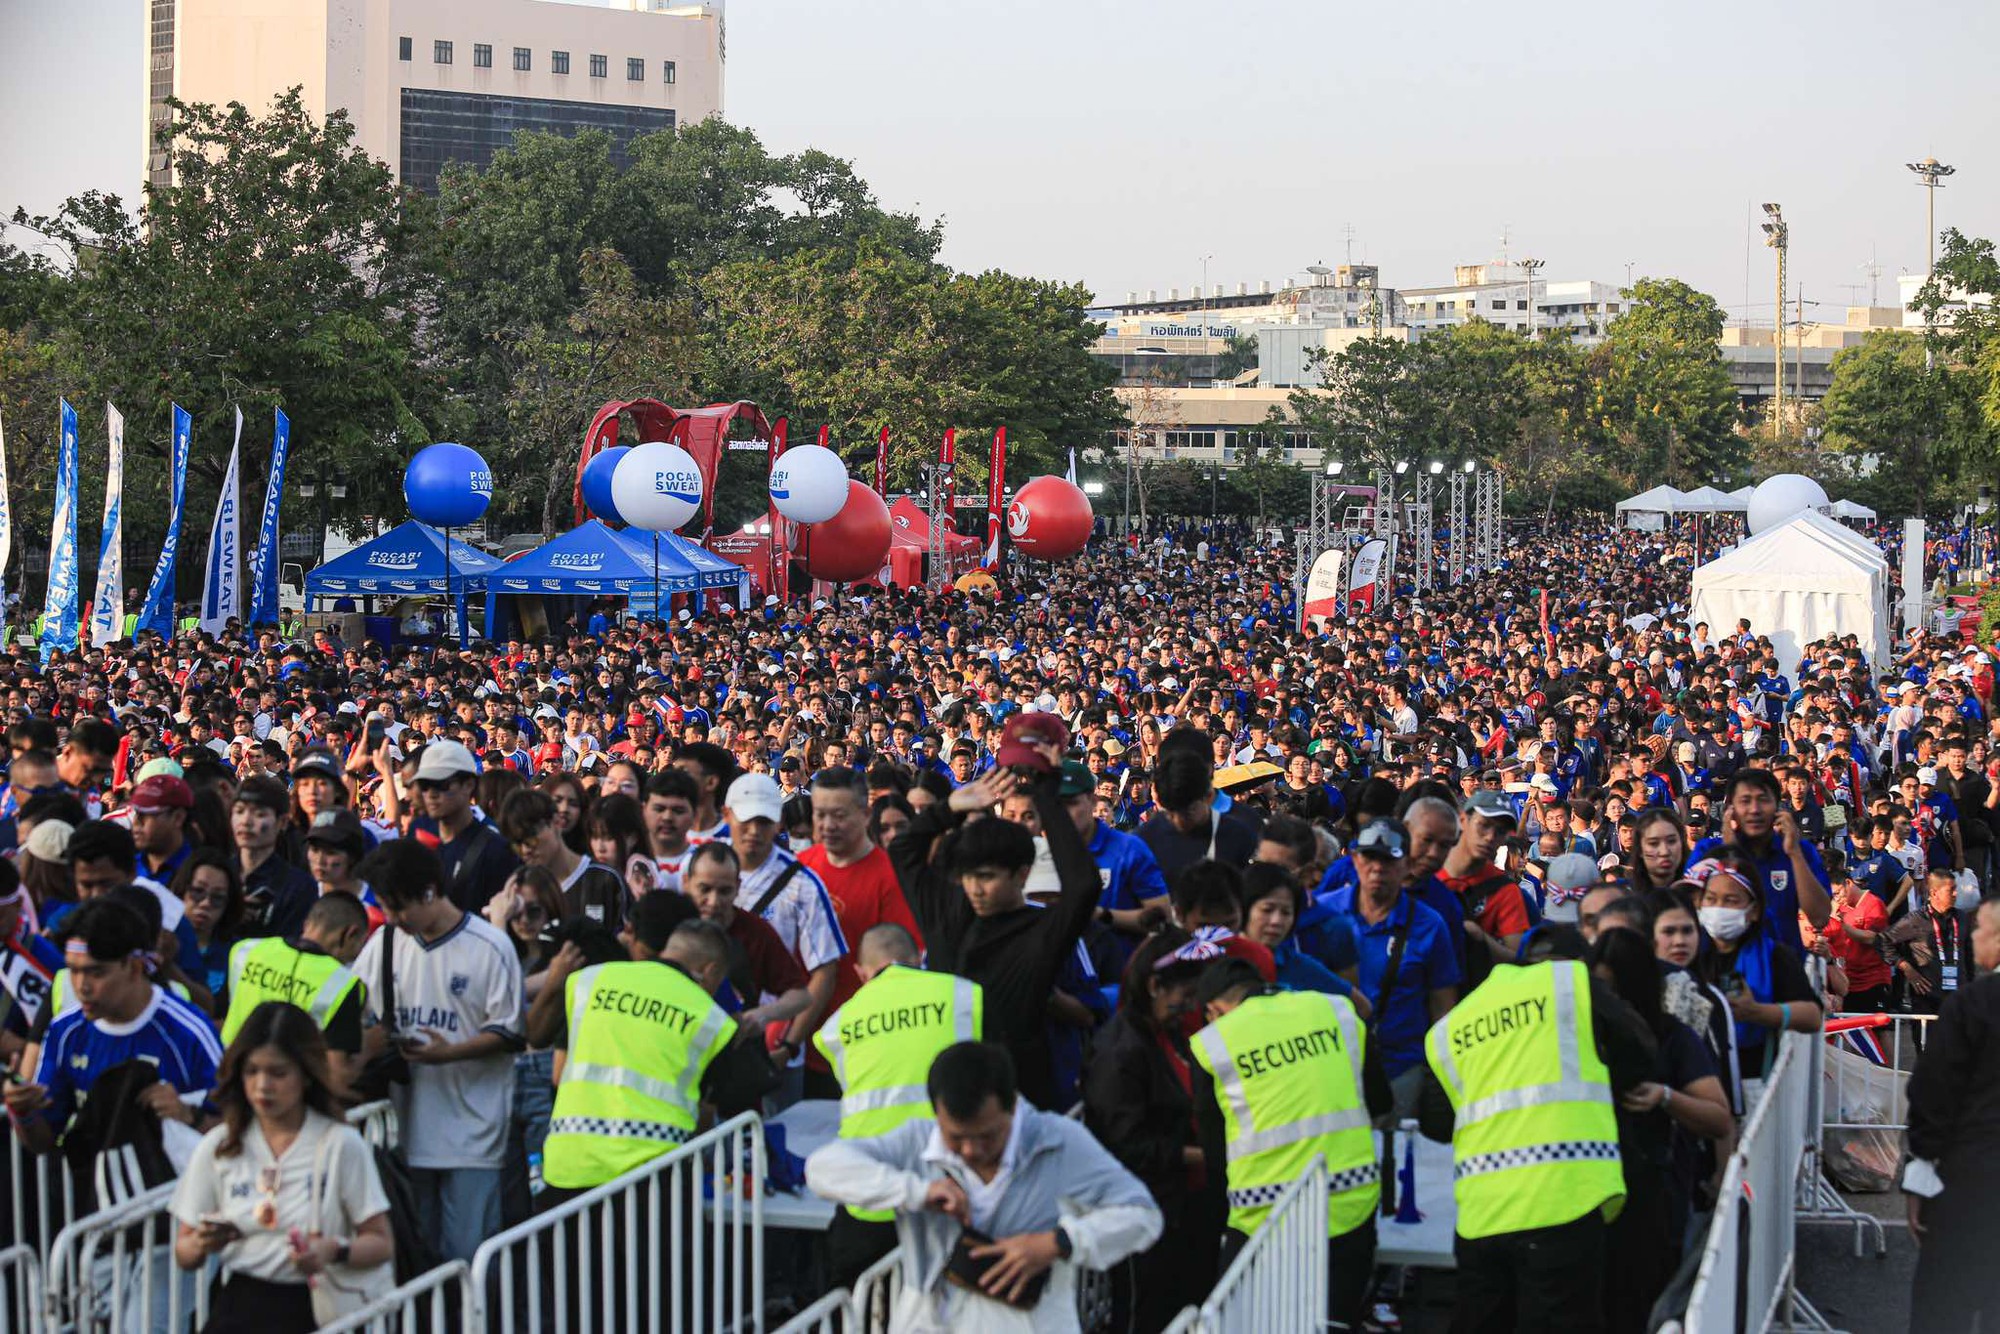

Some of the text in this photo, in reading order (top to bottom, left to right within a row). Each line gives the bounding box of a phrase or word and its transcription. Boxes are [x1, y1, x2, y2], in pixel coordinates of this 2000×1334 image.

[265, 435, 285, 527] POCARI
[656, 481, 699, 491] SWEAT
[220, 531, 234, 613] SWEAT
[367, 556, 415, 564] SWEAT
[370, 551, 422, 559] POCARI
[552, 552, 605, 560] POCARI
[241, 961, 317, 1002] SECURITY
[592, 989, 696, 1034] SECURITY
[841, 1002, 946, 1045] SECURITY
[1453, 996, 1547, 1056] SECURITY
[1237, 1026, 1340, 1079] SECURITY
